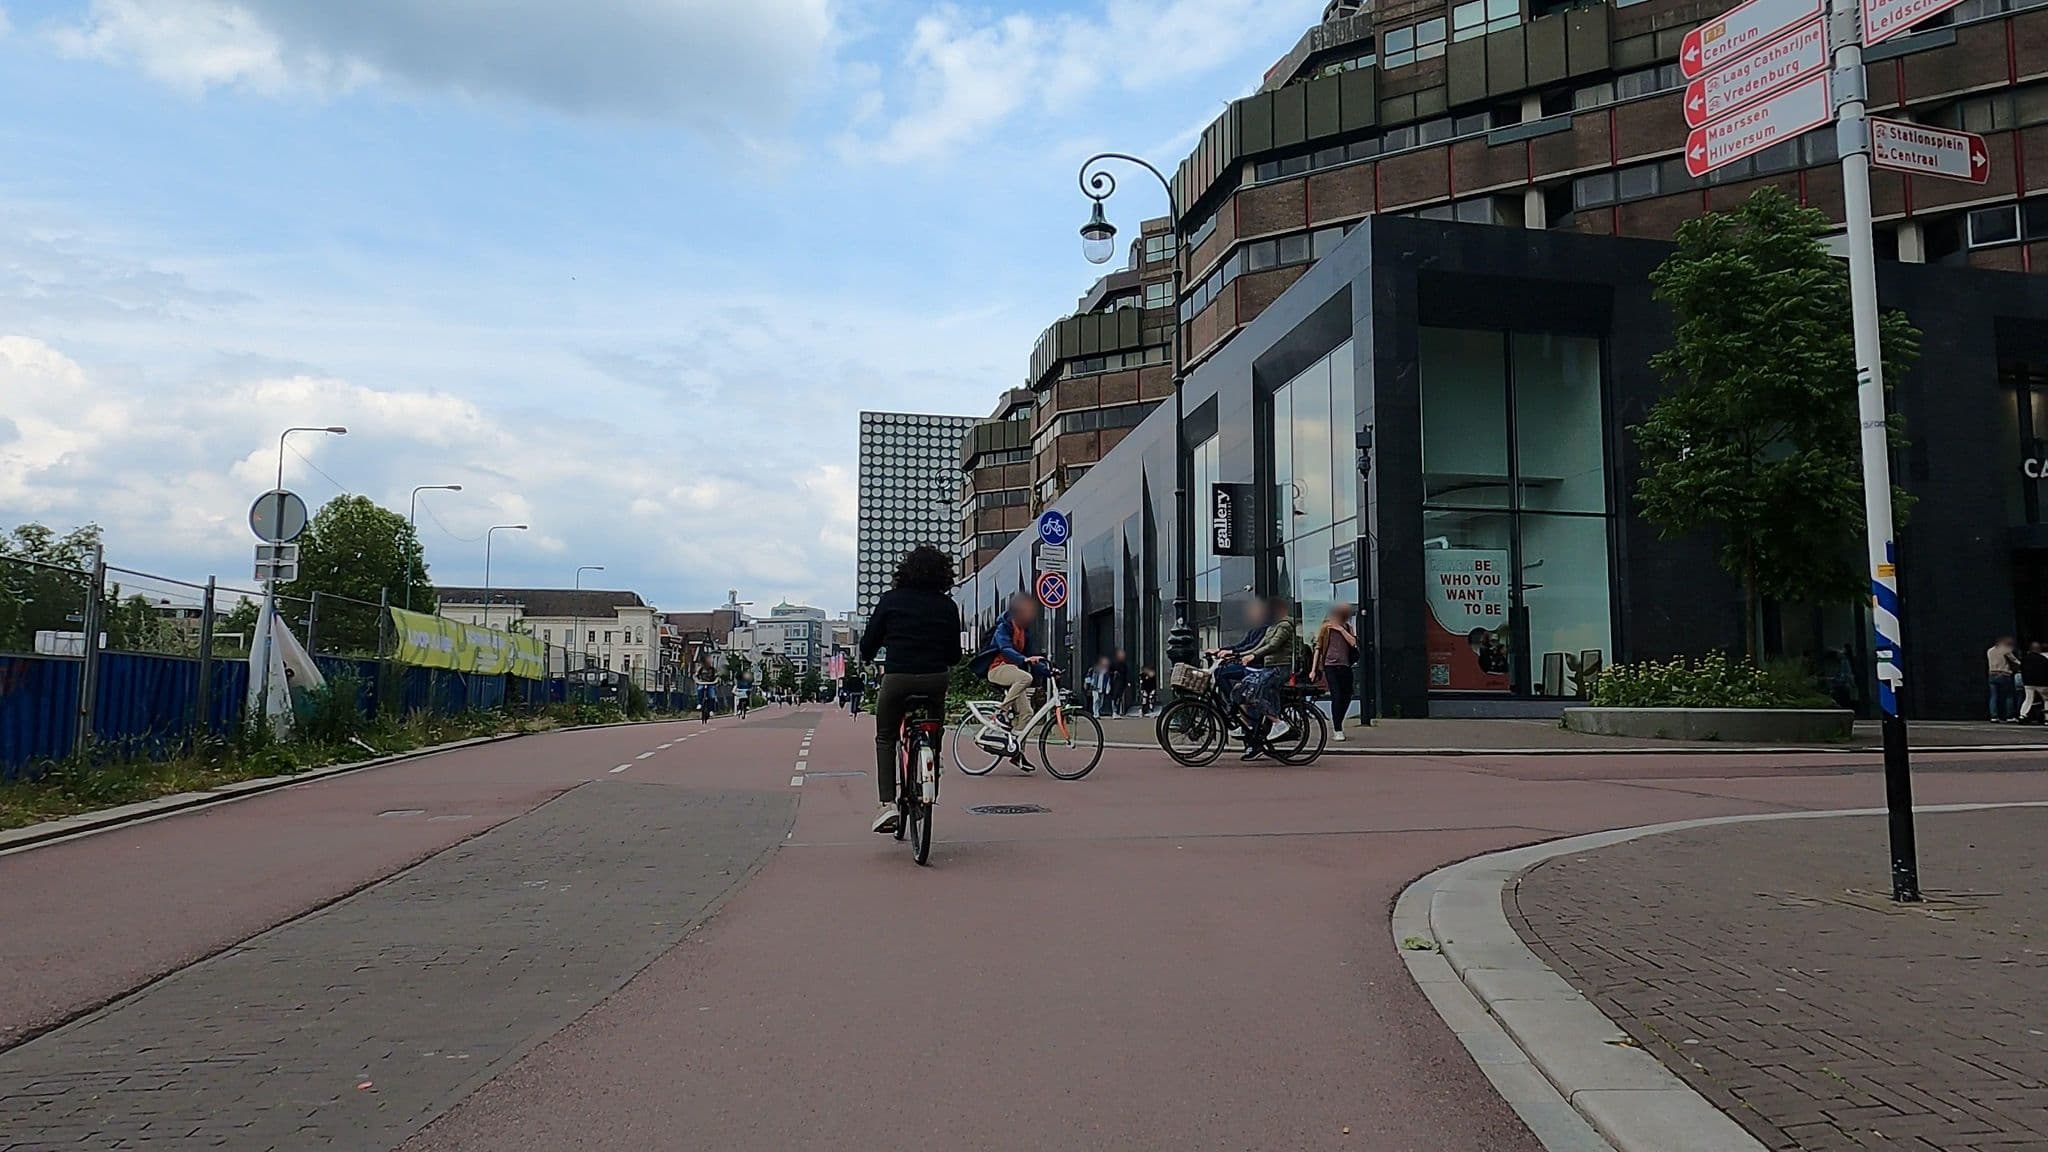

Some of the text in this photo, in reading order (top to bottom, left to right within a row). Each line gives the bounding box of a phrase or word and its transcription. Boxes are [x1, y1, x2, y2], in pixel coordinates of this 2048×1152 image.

[1704, 27, 1758, 60] Centrum
[1723, 30, 1819, 84] Laag Catharijne
[1724, 60, 1799, 101] Vredenburg
[1709, 108, 1768, 141] Maarssen
[1890, 127, 1963, 151] Stationsplein
[1710, 125, 1775, 160] Hilversum
[1890, 148, 1938, 167] Centraal
[1213, 489, 1231, 549] gallery
[1440, 574, 1500, 586] WHO YOU
[1446, 589, 1484, 600] WANT
[1464, 604, 1501, 615] TO BE
